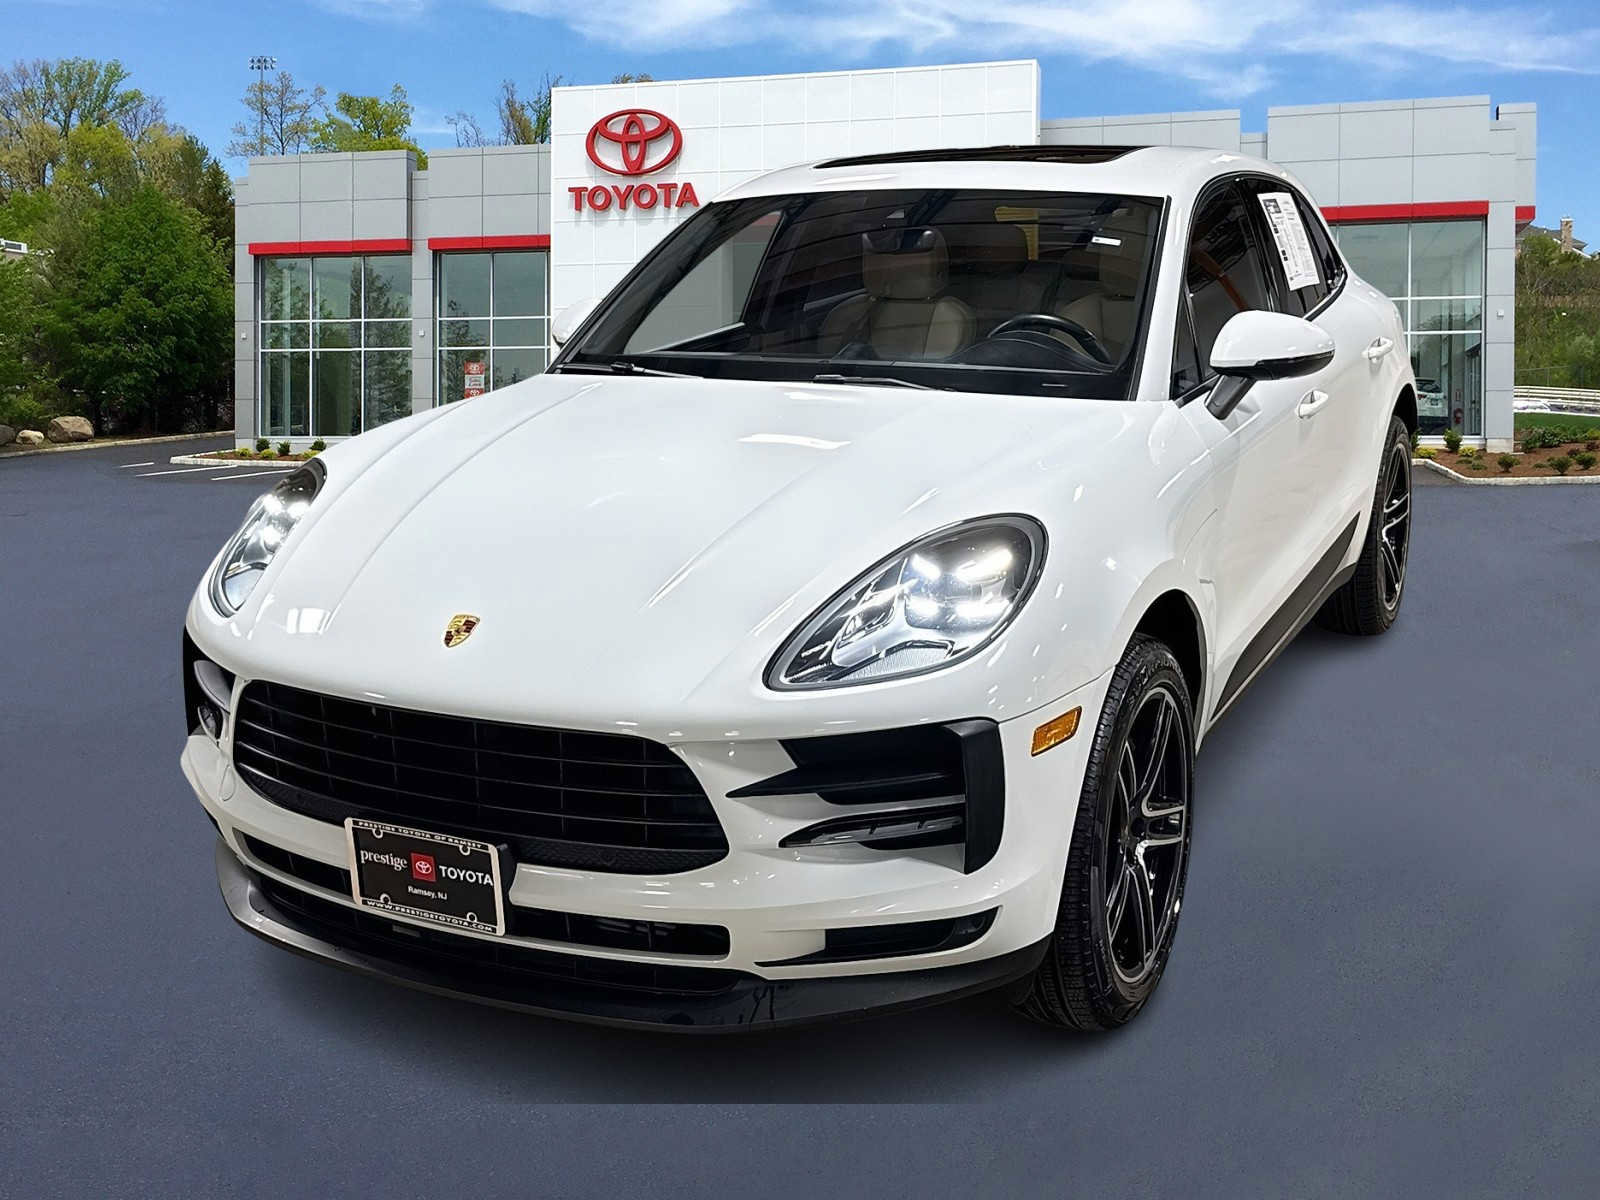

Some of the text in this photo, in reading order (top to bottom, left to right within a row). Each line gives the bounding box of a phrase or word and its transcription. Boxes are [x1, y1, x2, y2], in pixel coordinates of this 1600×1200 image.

[568, 182, 700, 212] TOYOTA
[398, 827, 431, 838] TOYOTA
[360, 849, 494, 887] prestige TOYOTA
[437, 891, 448, 900] NJ
